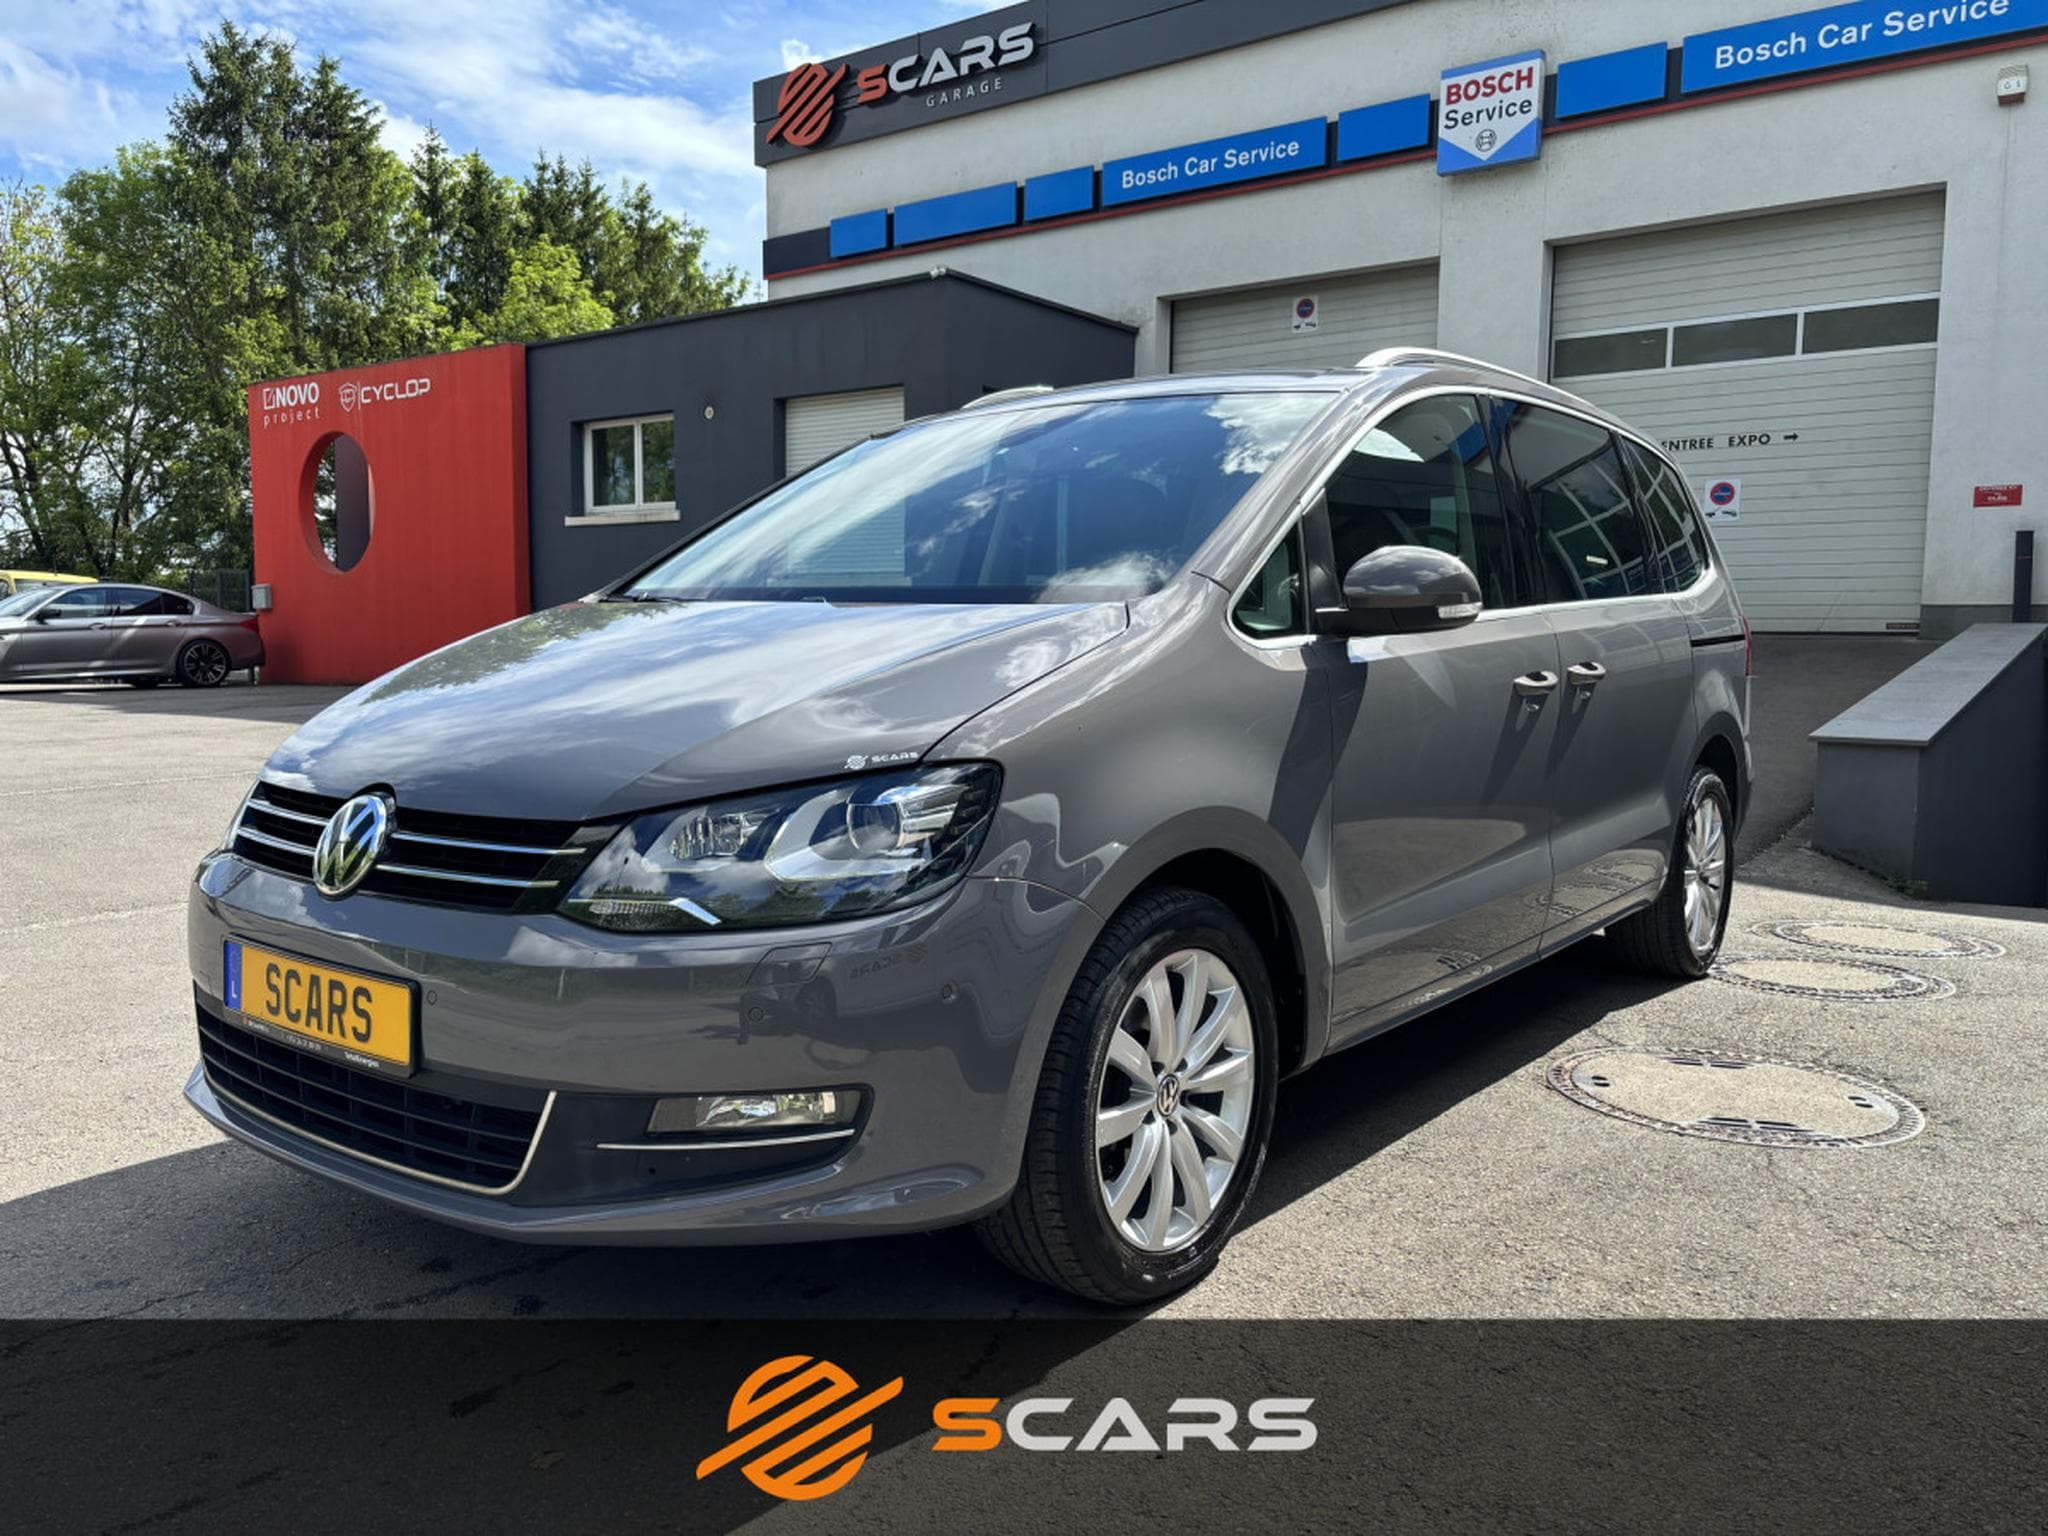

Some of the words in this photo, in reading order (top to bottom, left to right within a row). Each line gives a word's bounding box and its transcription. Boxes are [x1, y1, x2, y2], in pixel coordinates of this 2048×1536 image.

[1714, 32, 1807, 69] Bosch
[1818, 22, 1873, 49] Car
[1883, 0, 2010, 37] Service
[856, 21, 1035, 105] SCARS
[926, 77, 1003, 107] GARAGE
[1446, 66, 1533, 106] BOSCH
[1444, 99, 1532, 130] Service
[1122, 161, 1178, 189] Bosch
[1184, 156, 1218, 177] Car
[1224, 141, 1300, 169] Service
[361, 378, 431, 404] CYCLOP
[263, 407, 321, 430] project
[1728, 433, 1772, 448] EXPO
[871, 751, 919, 763] SCARS
[230, 980, 238, 998] L
[265, 962, 373, 1043] SCARS
